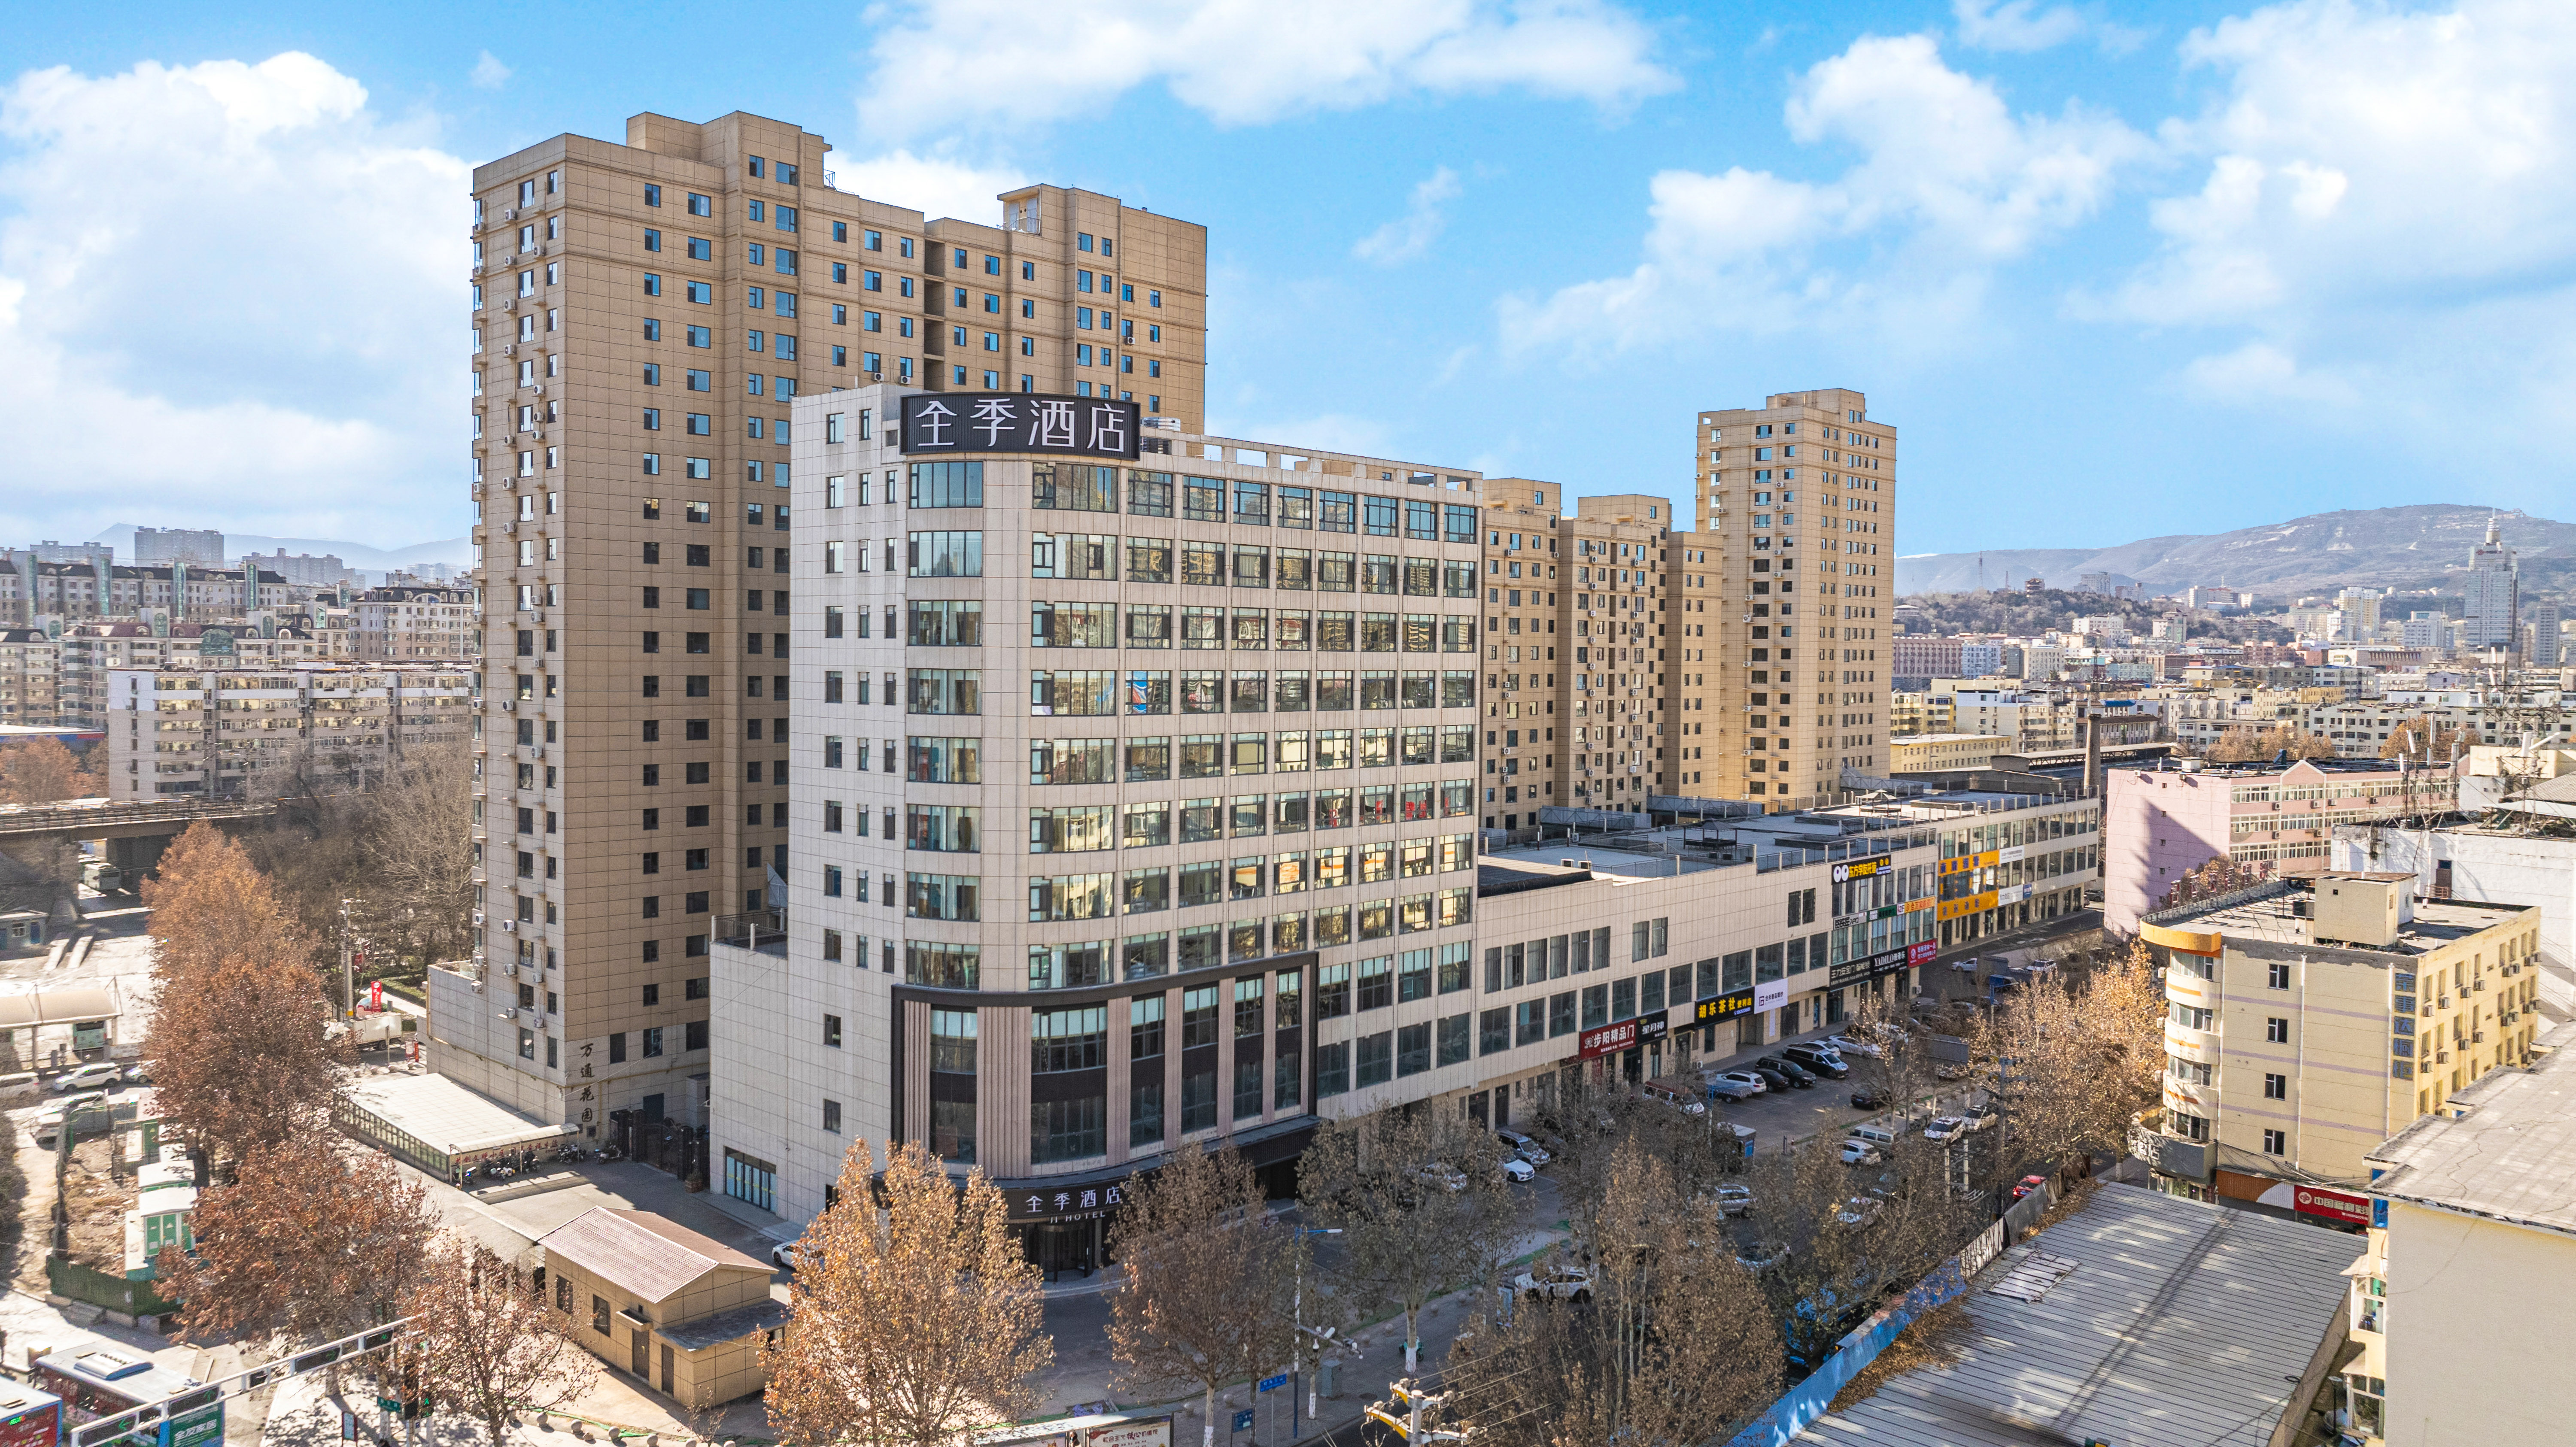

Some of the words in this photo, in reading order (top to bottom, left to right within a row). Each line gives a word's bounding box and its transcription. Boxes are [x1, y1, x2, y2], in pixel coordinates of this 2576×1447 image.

[915, 397, 1126, 453] 全季酒店
[1593, 1024, 1634, 1048] 步阳精品门
[1642, 1021, 1665, 1035] 星月神
[580, 1043, 595, 1122] 万通花园
[511, 1140, 558, 1154] 幸福生活
[1025, 1186, 1120, 1213] 全季酒店
[1065, 1210, 1106, 1223] HOTEL
[174, 1419, 217, 1439] 全友家居
